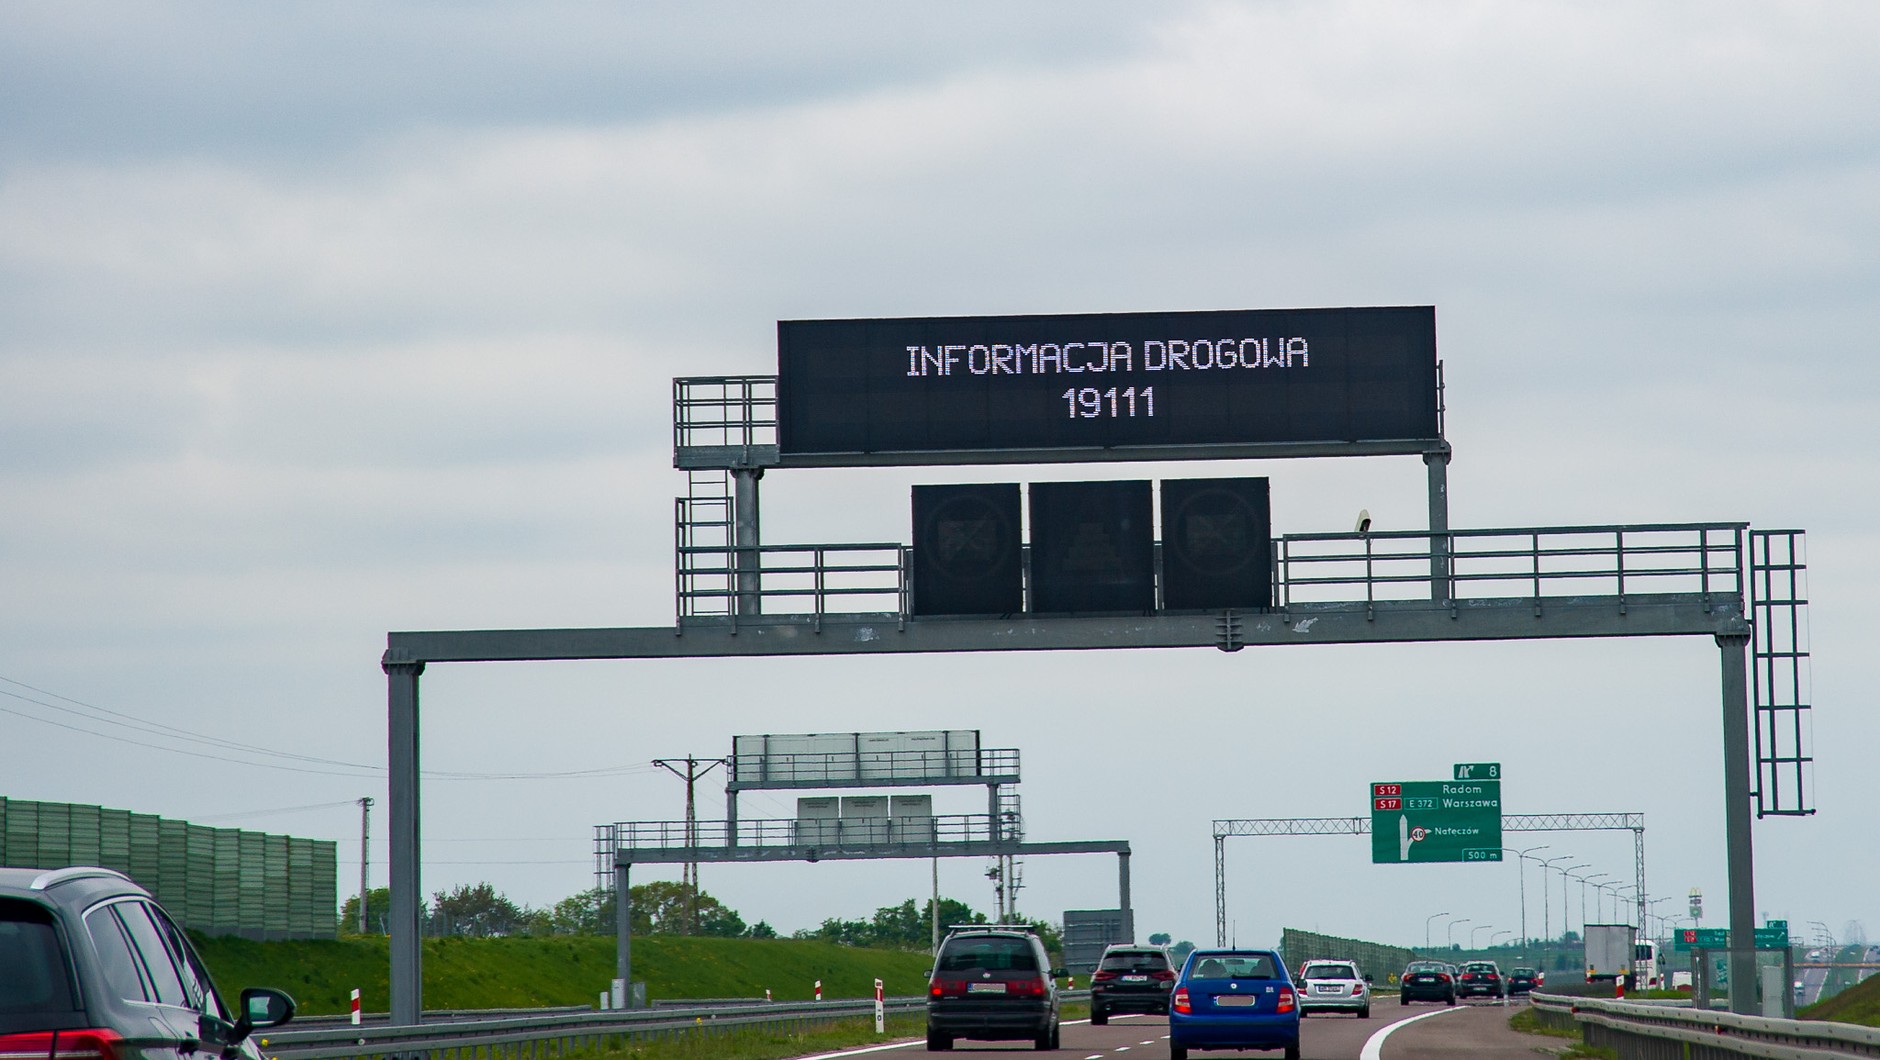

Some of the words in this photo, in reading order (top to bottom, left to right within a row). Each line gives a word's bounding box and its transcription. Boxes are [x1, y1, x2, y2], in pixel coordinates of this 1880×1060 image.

[906, 341, 1132, 376] INFORMACJA
[1144, 337, 1309, 371] DROGOWA
[1062, 386, 1154, 419] 19111
[1489, 766, 1497, 777] 8
[1443, 785, 1482, 794] Radom
[1417, 799, 1433, 808] 372
[1443, 798, 1498, 808] Warszawa
[1412, 830, 1423, 839] 40
[1434, 827, 1479, 837] Nałęczów
[1468, 851, 1485, 859] 500
